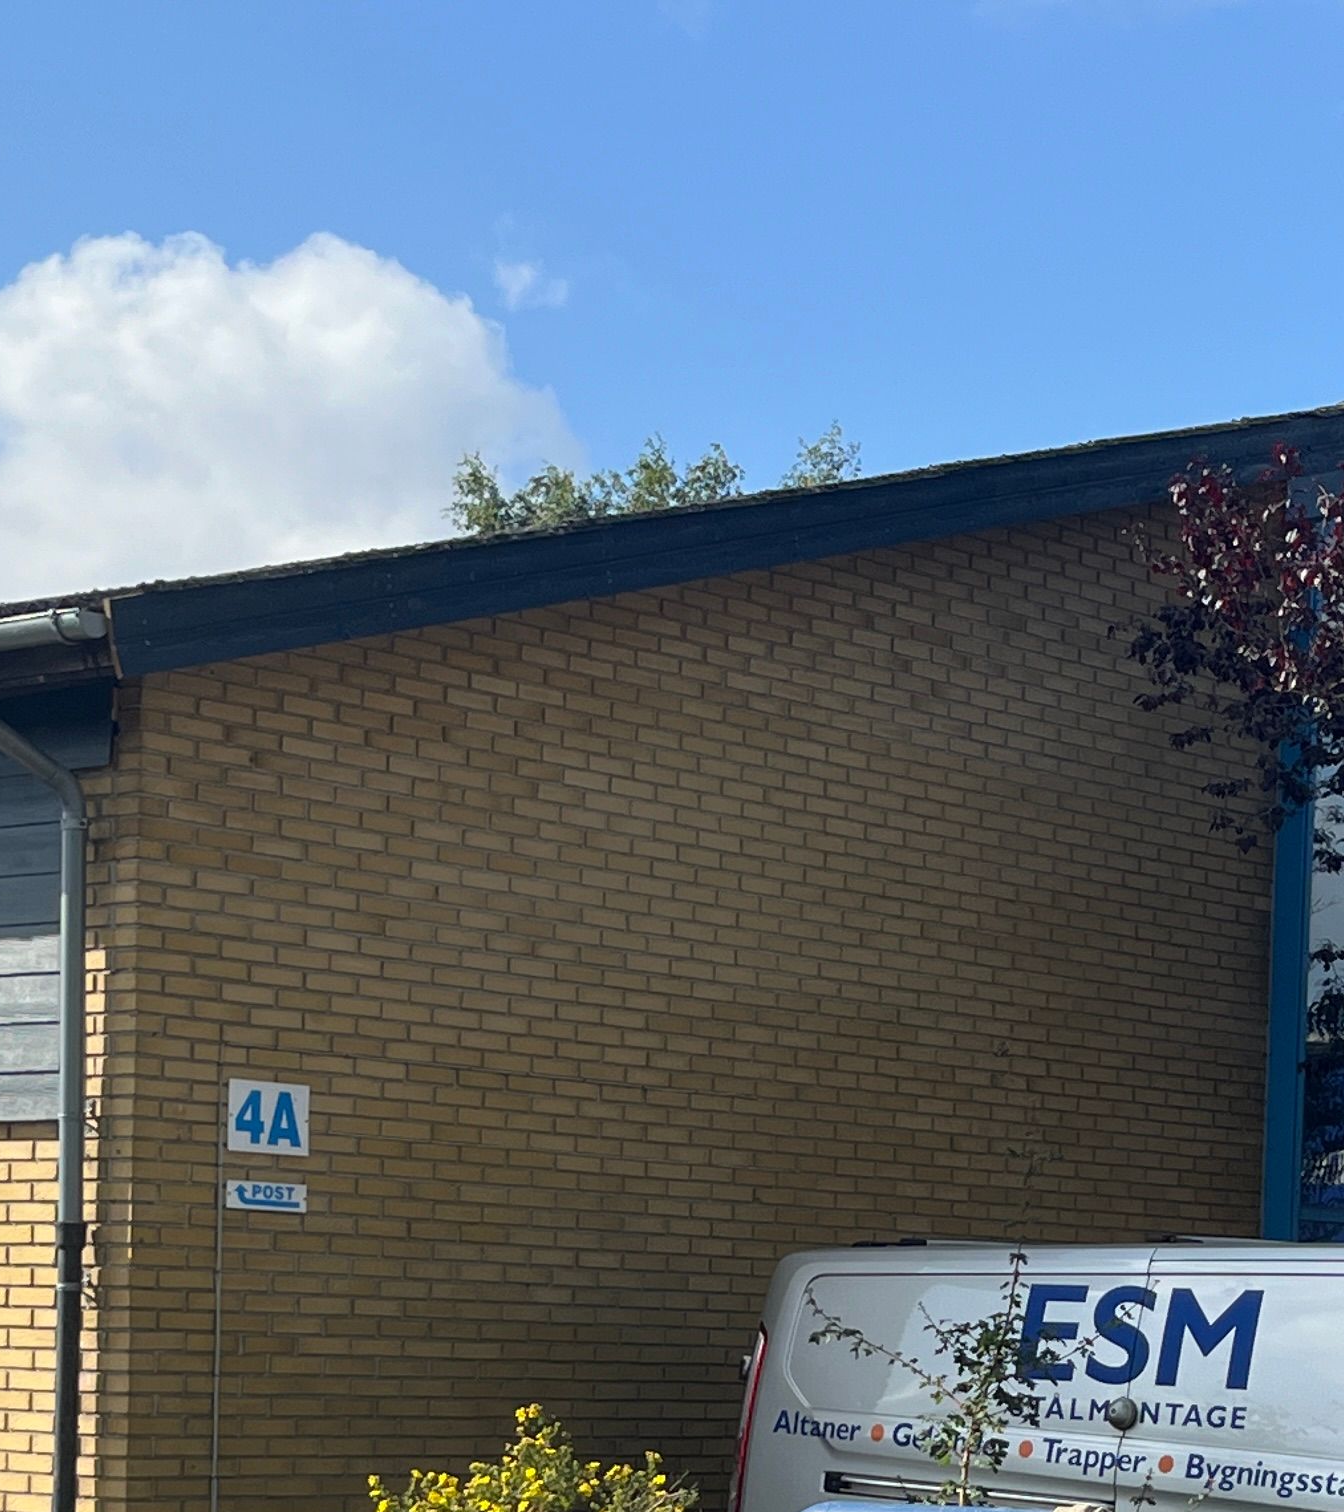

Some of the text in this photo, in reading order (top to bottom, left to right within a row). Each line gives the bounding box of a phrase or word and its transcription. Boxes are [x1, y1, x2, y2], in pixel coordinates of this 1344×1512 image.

[235, 1090, 301, 1148] 4A
[251, 1184, 295, 1201] POST
[1017, 1283, 1265, 1390] ESM
[773, 1410, 861, 1441] Altaner
[1043, 1437, 1147, 1477] Trapper
